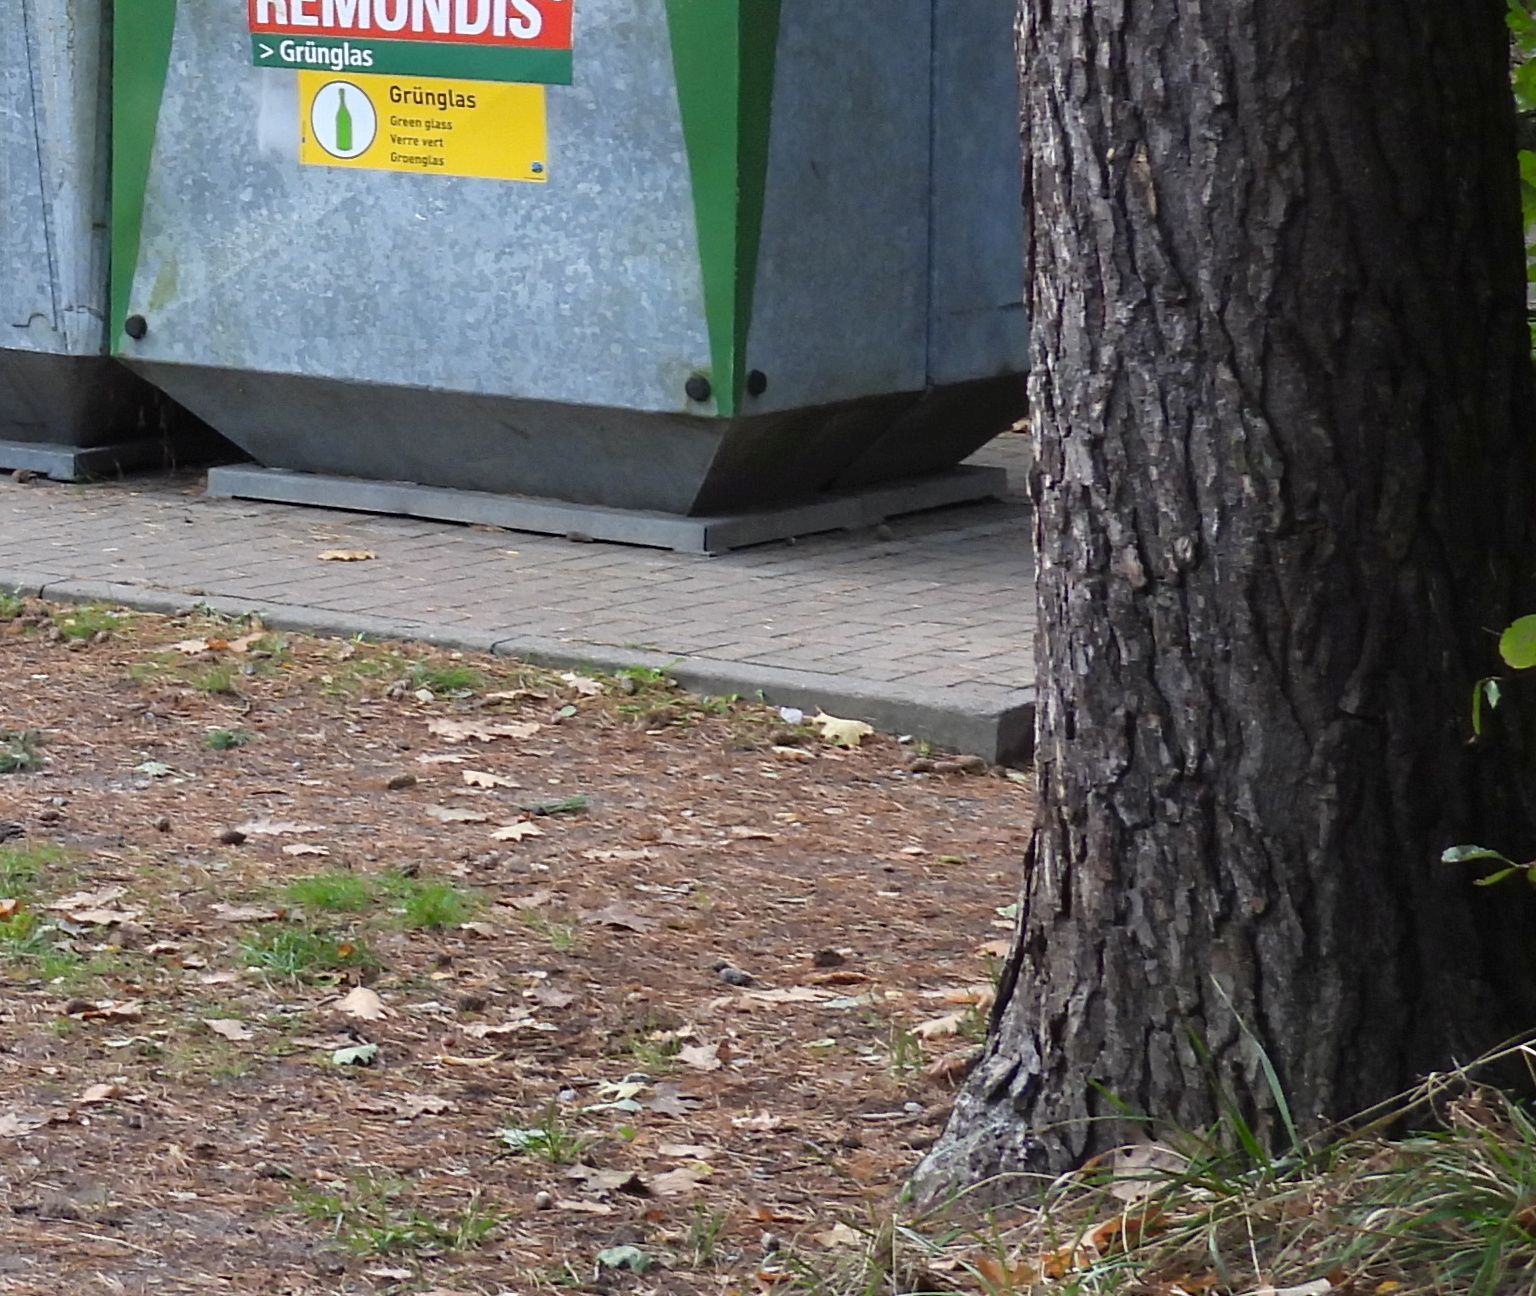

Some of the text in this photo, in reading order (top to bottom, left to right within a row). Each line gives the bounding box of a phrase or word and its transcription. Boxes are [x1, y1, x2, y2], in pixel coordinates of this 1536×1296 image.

[280, 40, 374, 71] Grünglas
[389, 85, 477, 110] Grünglas
[390, 115, 453, 131] Green glass
[390, 134, 444, 148] Verre vert
[390, 152, 445, 167] Groenglas
